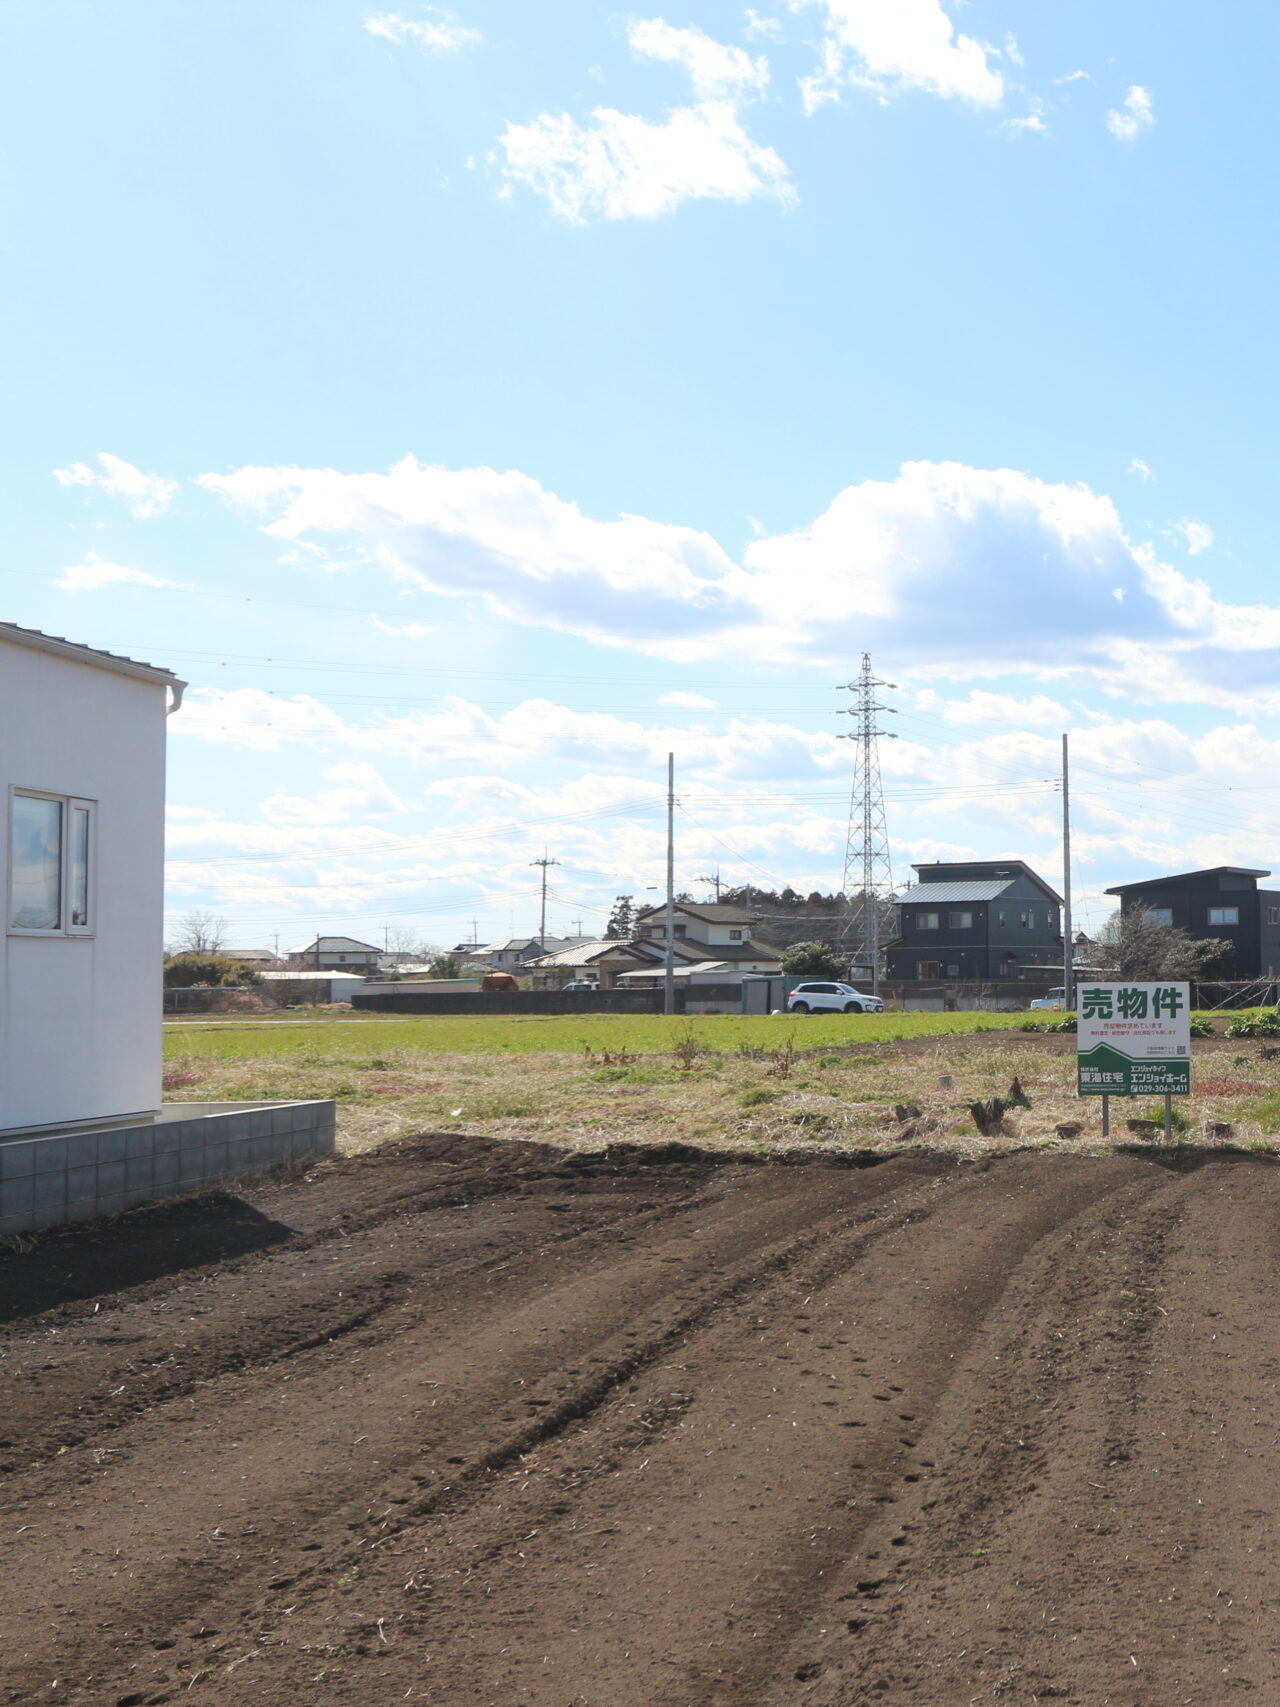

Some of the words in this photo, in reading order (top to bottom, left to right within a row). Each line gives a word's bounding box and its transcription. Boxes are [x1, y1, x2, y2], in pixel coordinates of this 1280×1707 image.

[1082, 987, 1184, 1020] 売物件
[1080, 1072, 1124, 1083] 東海住宅
[1138, 1084, 1188, 1092] 029-306-3411
